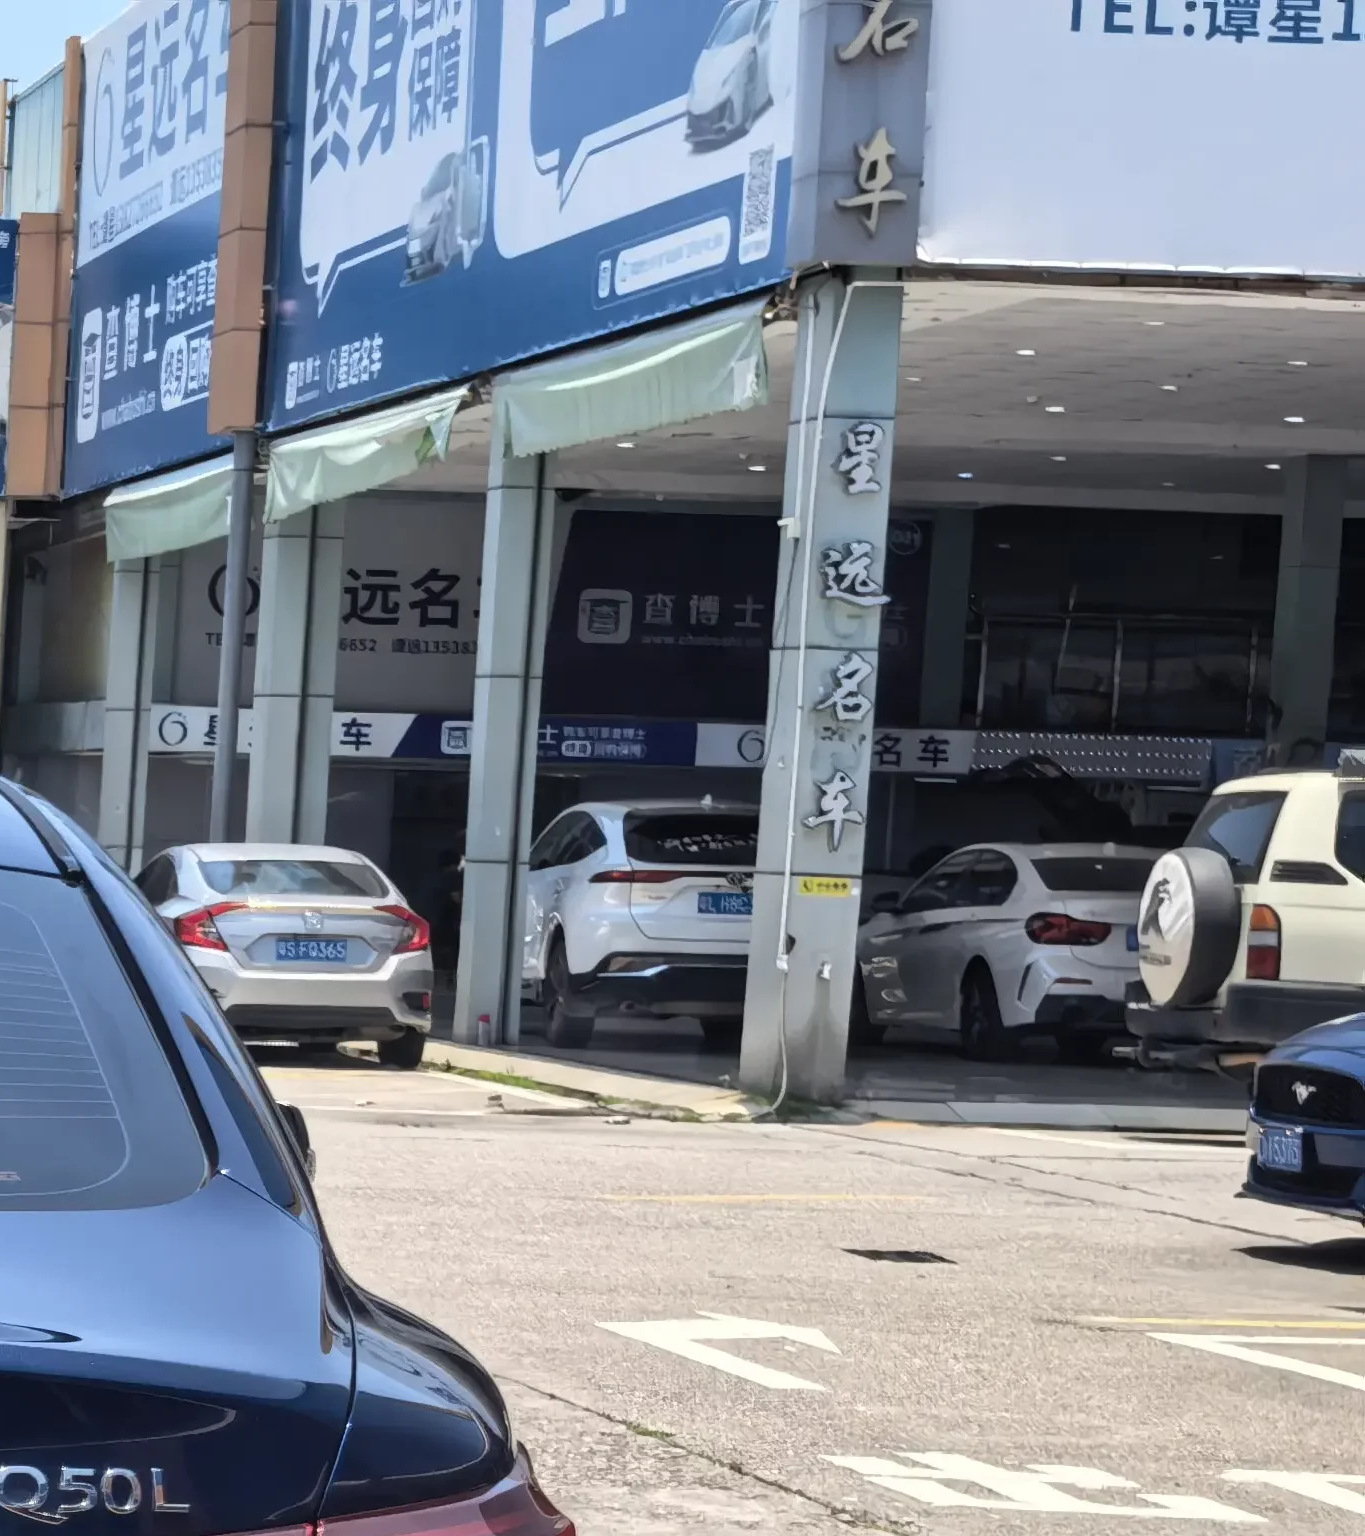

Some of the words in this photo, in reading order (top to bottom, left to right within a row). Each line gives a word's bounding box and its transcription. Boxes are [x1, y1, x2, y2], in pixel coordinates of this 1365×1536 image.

[341, 567, 482, 629] 远名
[801, 421, 891, 852] 星远名车
